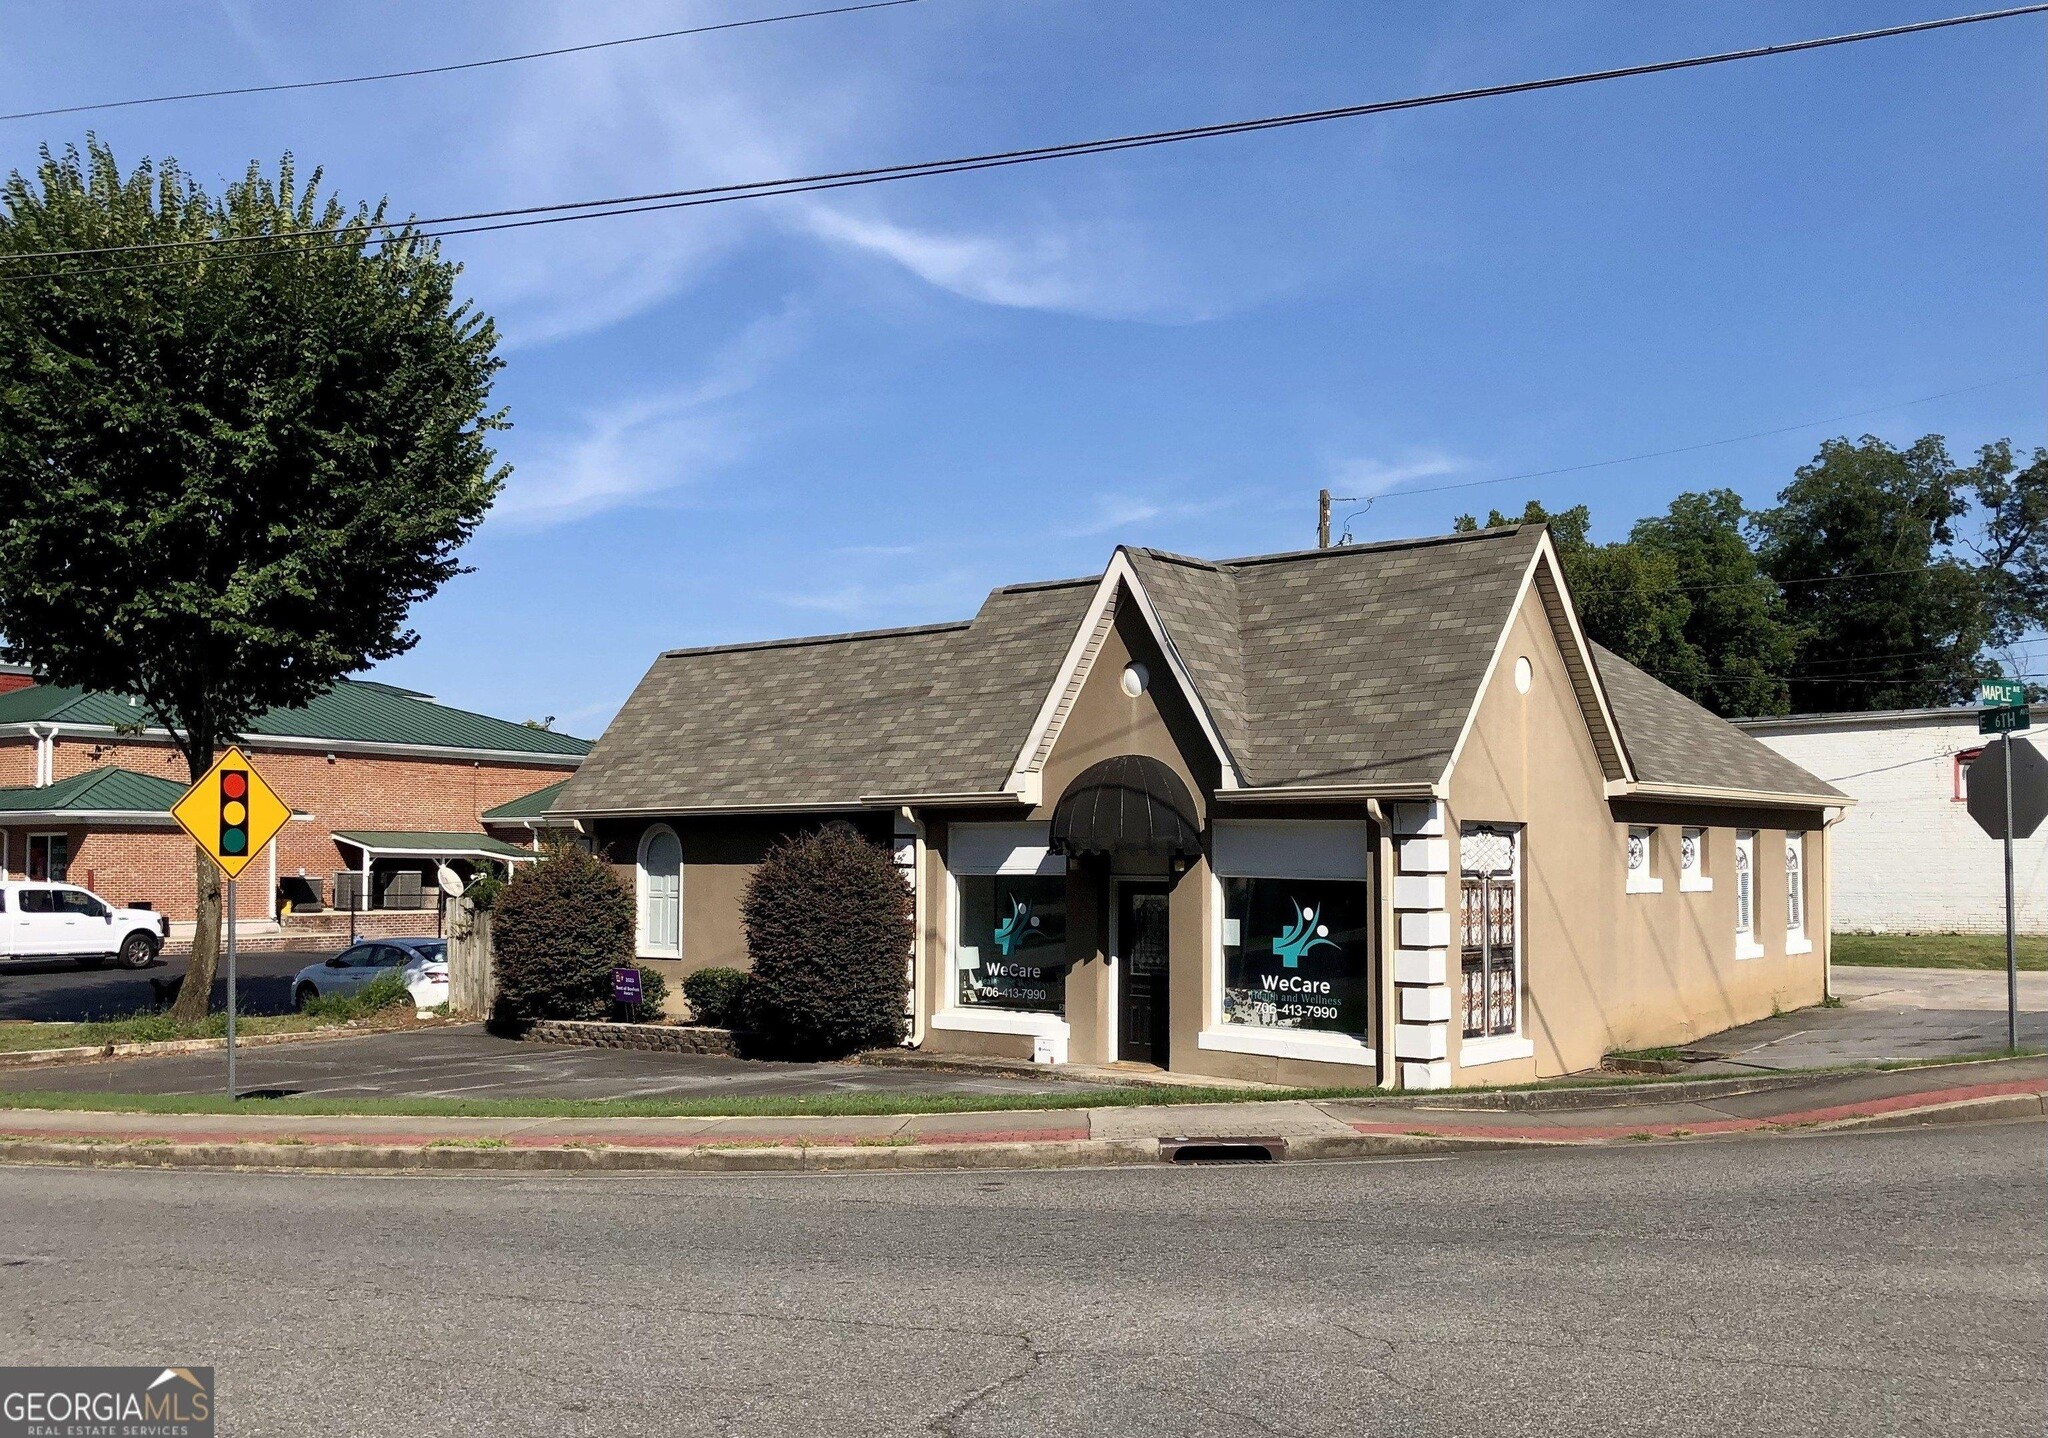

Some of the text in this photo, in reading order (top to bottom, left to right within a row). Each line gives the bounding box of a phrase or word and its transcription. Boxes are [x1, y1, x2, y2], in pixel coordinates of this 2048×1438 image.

[1982, 684, 2012, 702] MAPLE
[1980, 715, 1987, 730] E
[1995, 711, 2016, 728] 6TH
[986, 962, 1041, 978] WeCare
[981, 986, 1046, 1000] 706-413-7990
[1261, 974, 1331, 994] WeCare
[1281, 992, 1298, 1003] and
[1300, 993, 1342, 1006] Wellness
[1253, 1001, 1338, 1019] 706-413-7990
